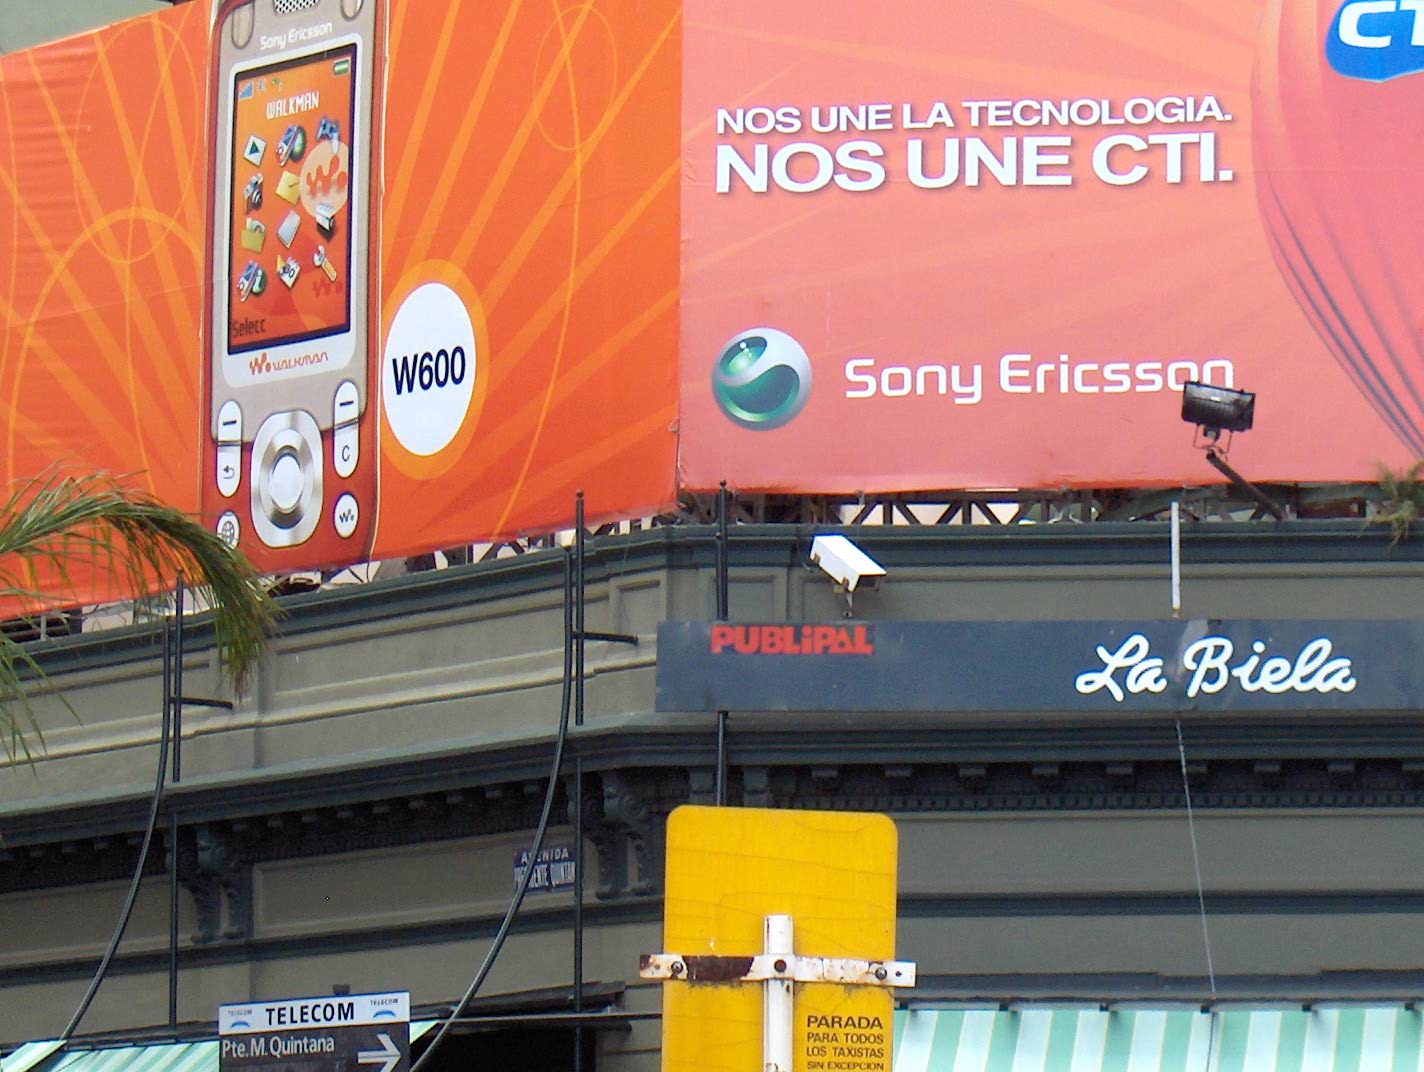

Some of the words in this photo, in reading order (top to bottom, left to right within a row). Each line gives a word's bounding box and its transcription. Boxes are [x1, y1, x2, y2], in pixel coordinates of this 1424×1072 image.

[260, 34, 287, 50] Sony
[288, 22, 333, 44] Ericsson
[266, 91, 320, 119] WALKMAN
[716, 106, 802, 134] NOS
[810, 103, 893, 132] UNE
[902, 102, 955, 129] LA
[961, 96, 1232, 127] TECNOLOGIA.
[716, 140, 886, 193] NOS
[907, 135, 1073, 189] UNE
[1091, 132, 1233, 186] CTI.
[392, 345, 466, 396] W600
[845, 357, 982, 405] Sony
[1000, 353, 1234, 395] Ericsson
[1075, 633, 1168, 702] La
[1183, 636, 1357, 698] Biela
[265, 1002, 355, 1026] TELECOM
[807, 1015, 884, 1030] PARADA
[806, 1046, 827, 1057] LOS
[832, 1047, 884, 1058] TAXISTAS
[807, 1032, 839, 1043] PARA
[844, 1033, 884, 1045] TODOS
[807, 1061, 824, 1070] SIN
[828, 1062, 884, 1071] EXCEPCION
